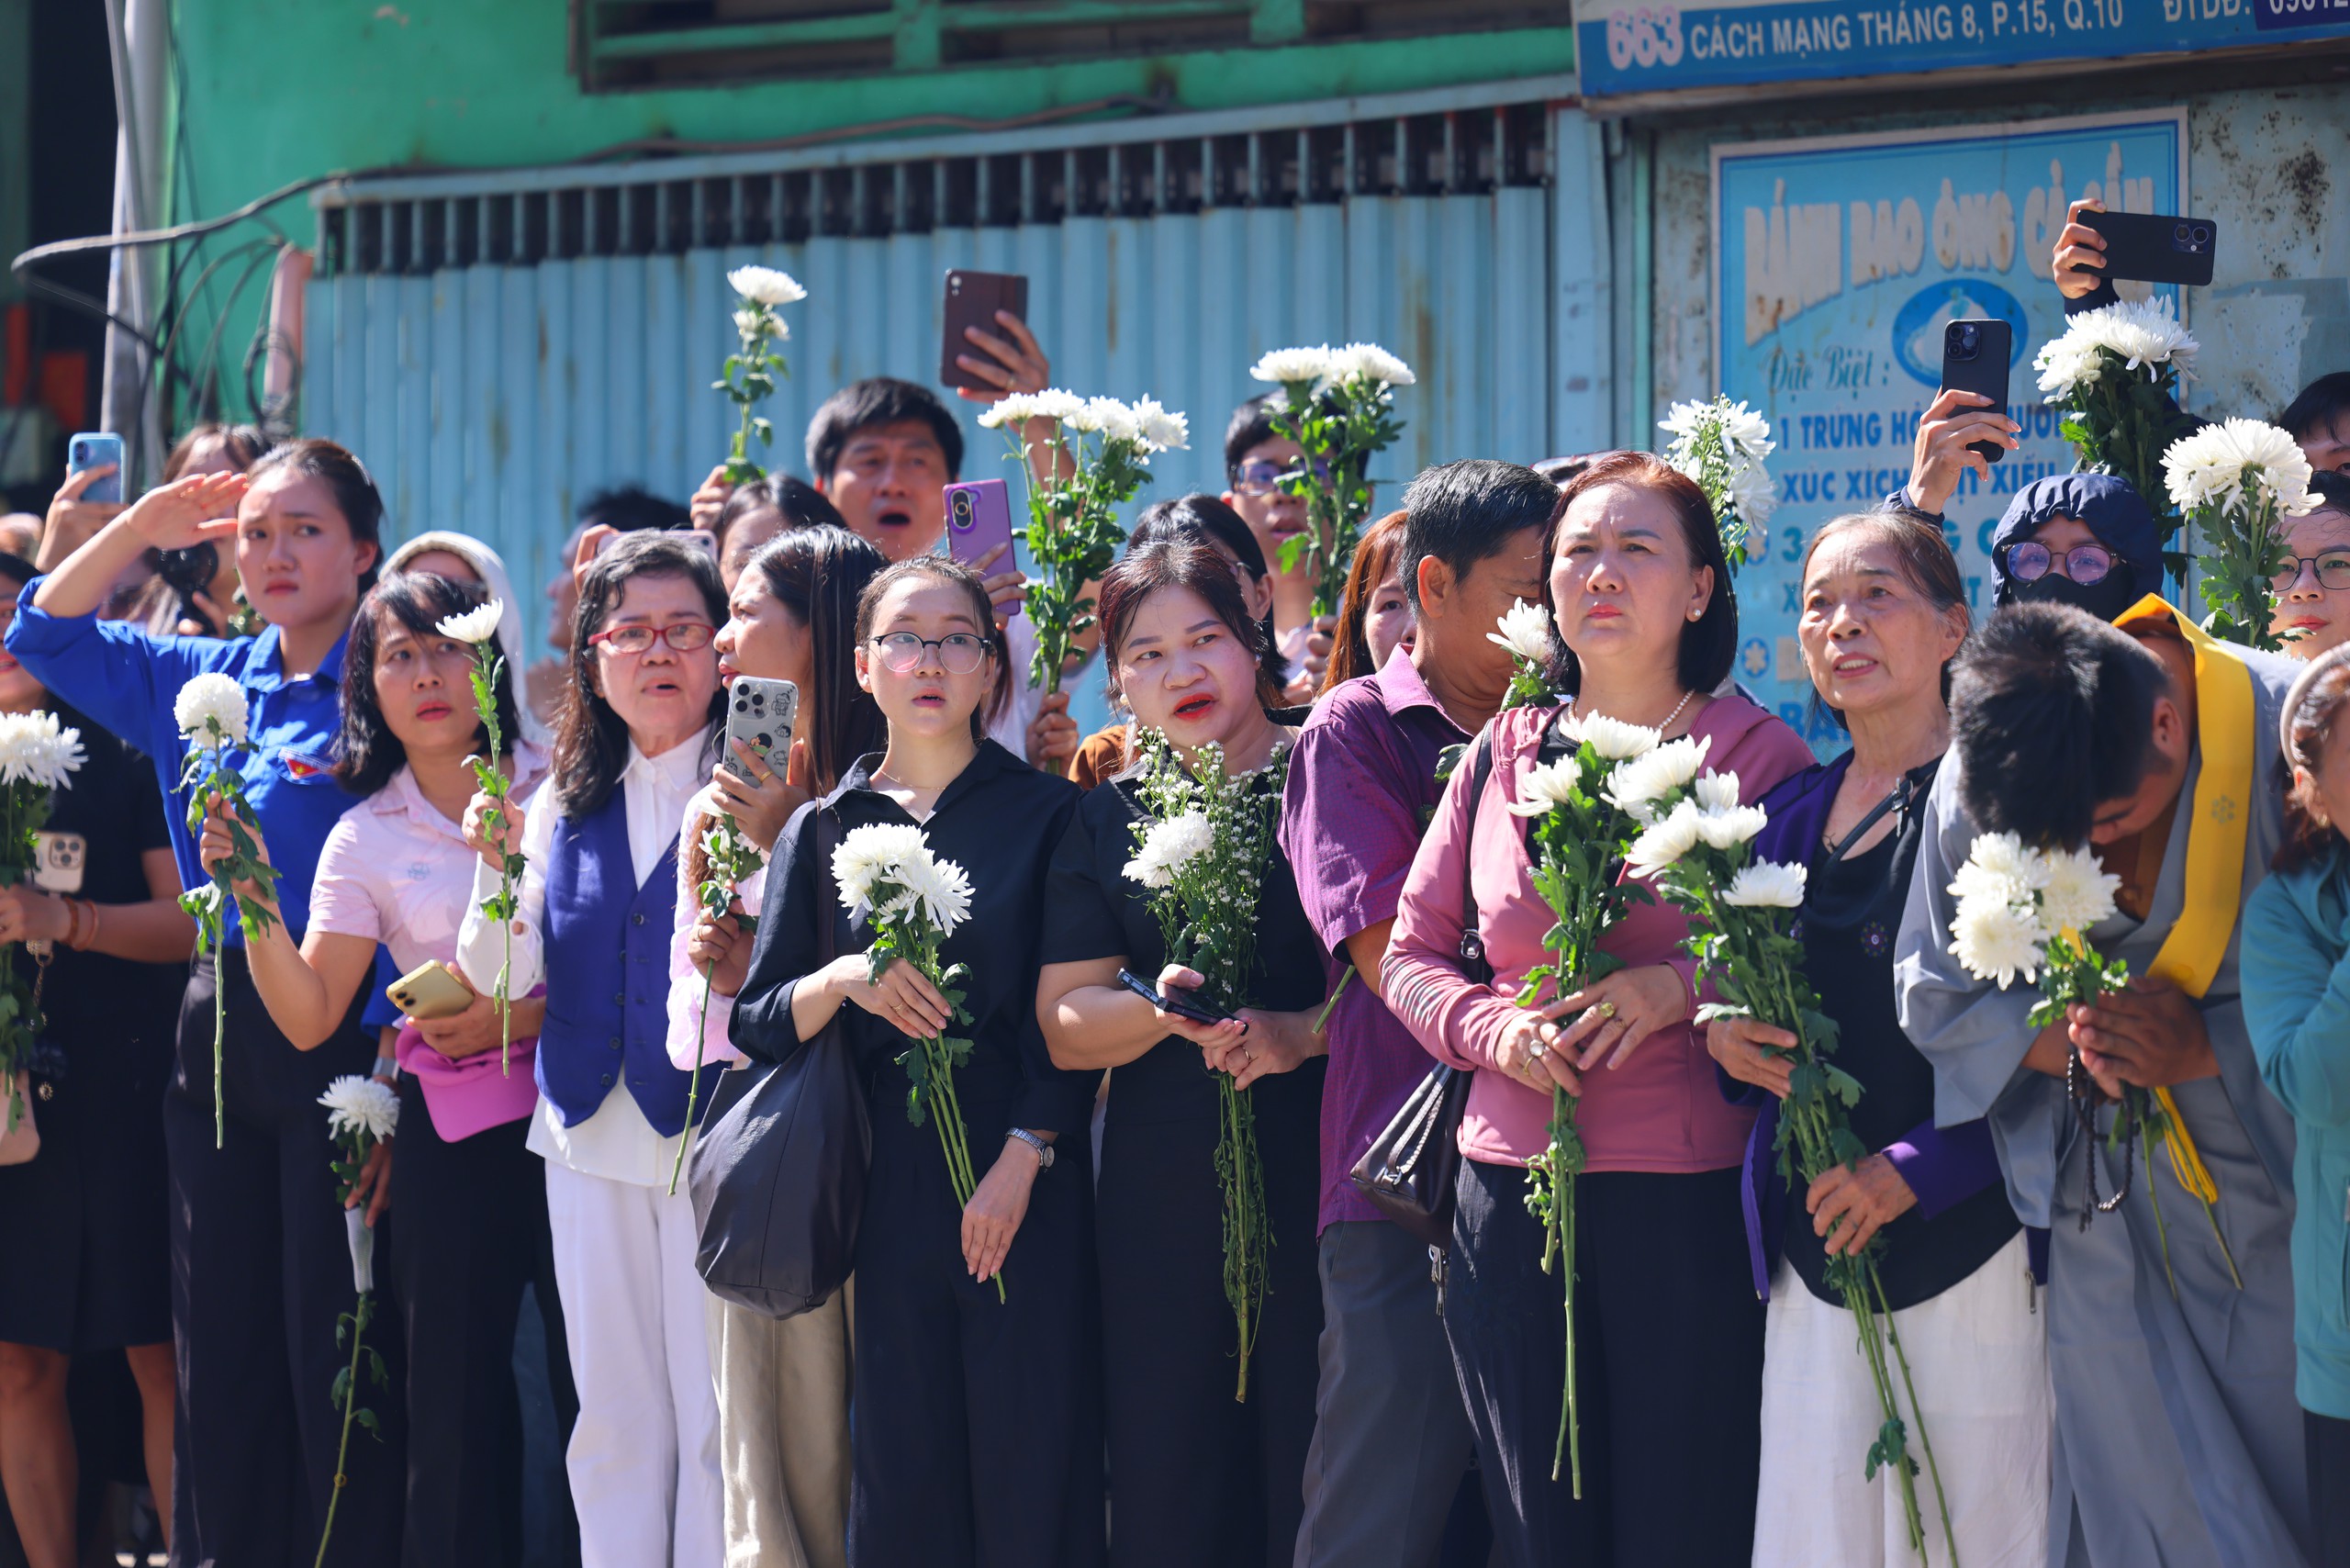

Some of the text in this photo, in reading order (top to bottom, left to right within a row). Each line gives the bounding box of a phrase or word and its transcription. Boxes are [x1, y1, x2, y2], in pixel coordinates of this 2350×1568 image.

[1607, 6, 1684, 70] 663
[1691, 15, 1763, 59] CÁCH
[1772, 15, 1851, 59] MẠNG
[1858, 1, 1953, 47] THÁNG
[1961, 4, 1984, 43] 8,
